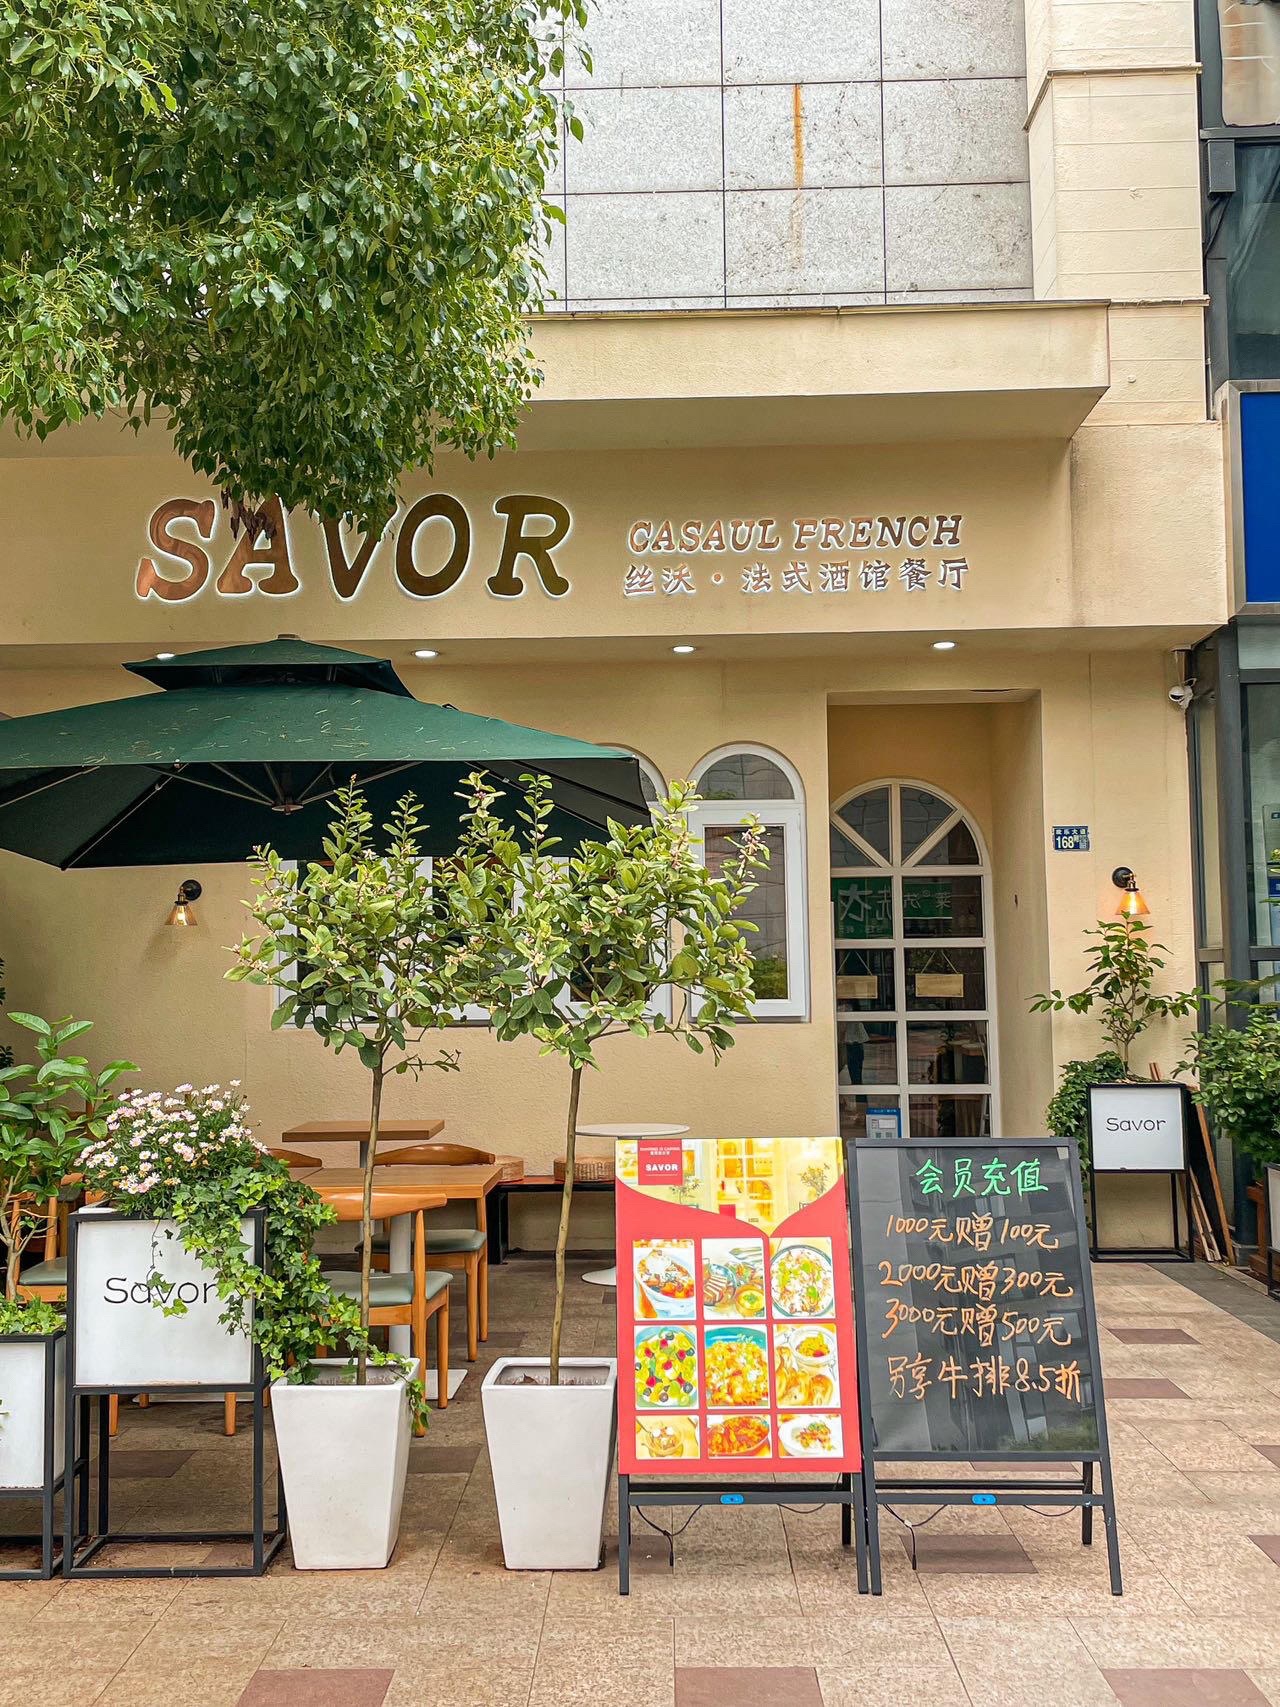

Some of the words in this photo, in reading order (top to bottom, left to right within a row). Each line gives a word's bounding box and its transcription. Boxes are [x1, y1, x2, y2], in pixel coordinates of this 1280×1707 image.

[136, 493, 571, 600] SAVOR
[628, 519, 781, 552] CASAUL
[793, 515, 962, 549] FRENCH
[1106, 1117, 1166, 1132] Savor
[645, 1163, 679, 1172] SAVOR
[916, 1157, 1049, 1198] 会员充值
[103, 1277, 219, 1304] Savor
